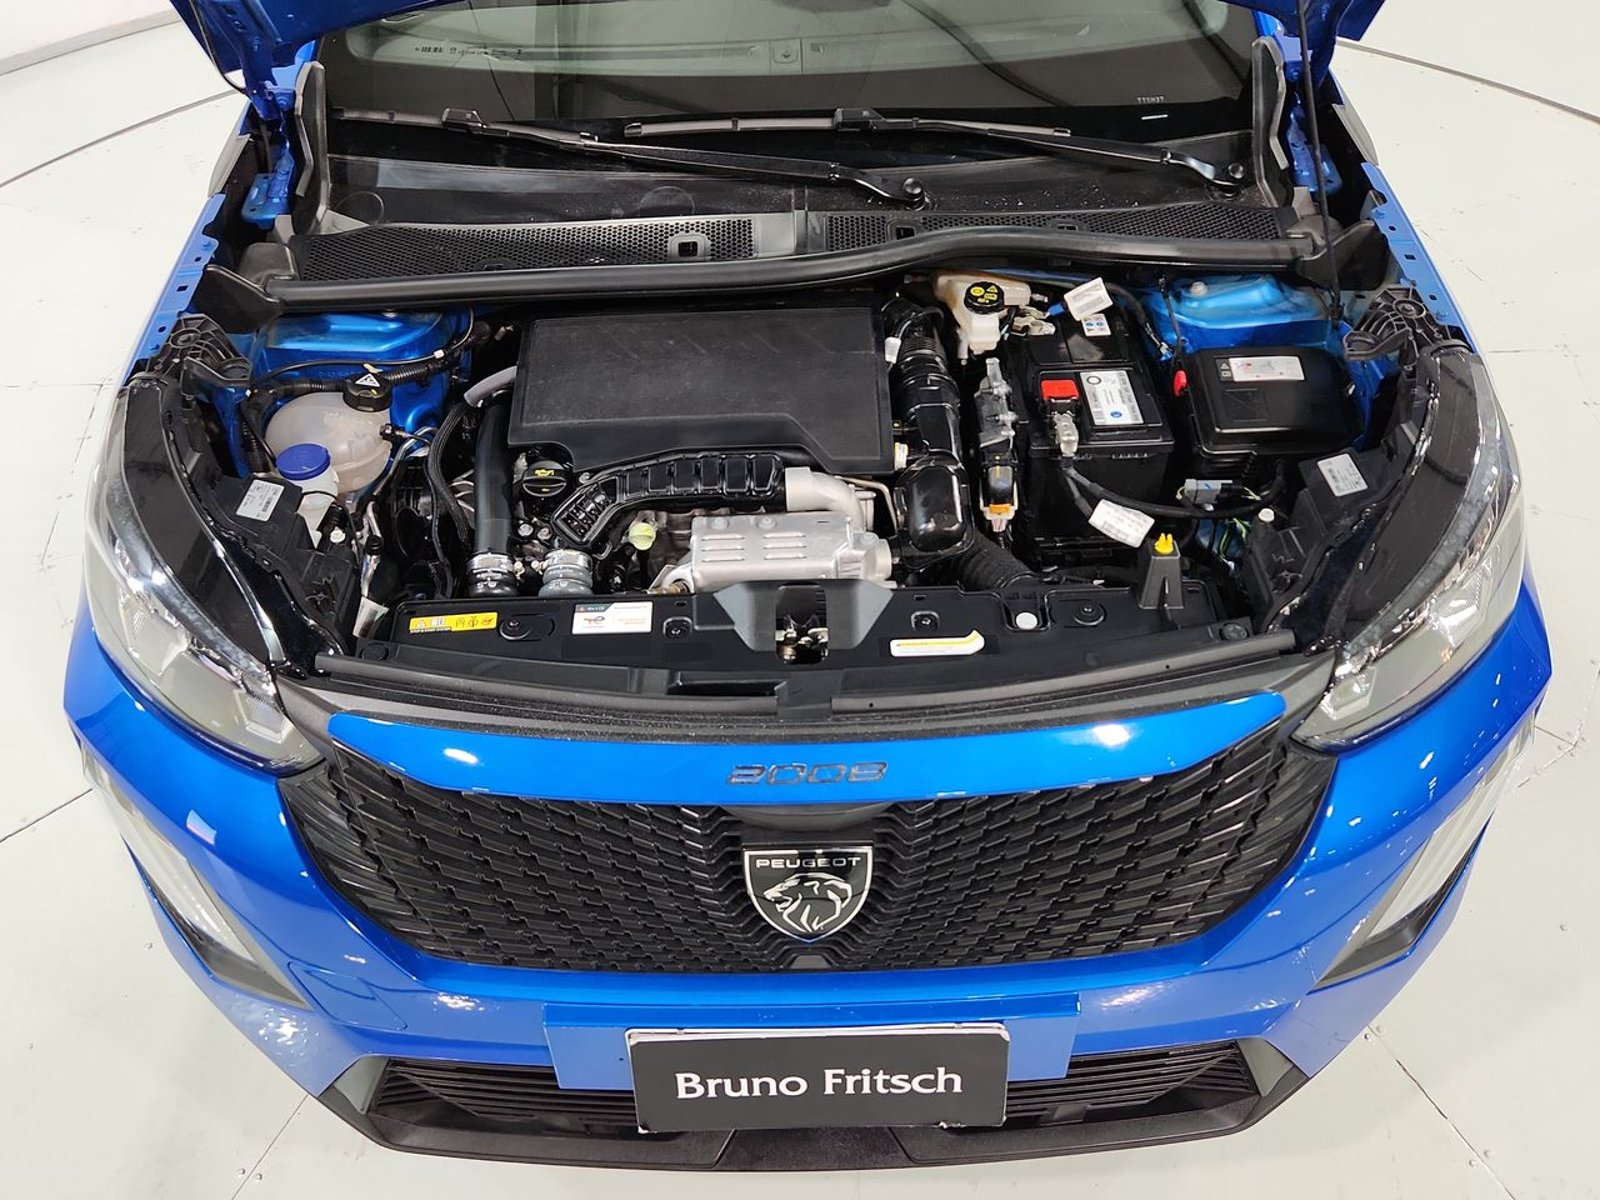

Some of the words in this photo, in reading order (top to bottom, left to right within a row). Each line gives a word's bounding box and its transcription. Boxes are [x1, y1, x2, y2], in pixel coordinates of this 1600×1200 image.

[728, 762, 888, 785] 2008
[756, 857, 861, 868] PEUGEOT
[675, 1073, 807, 1099] Bruno
[824, 1067, 962, 1095] Fritsch
